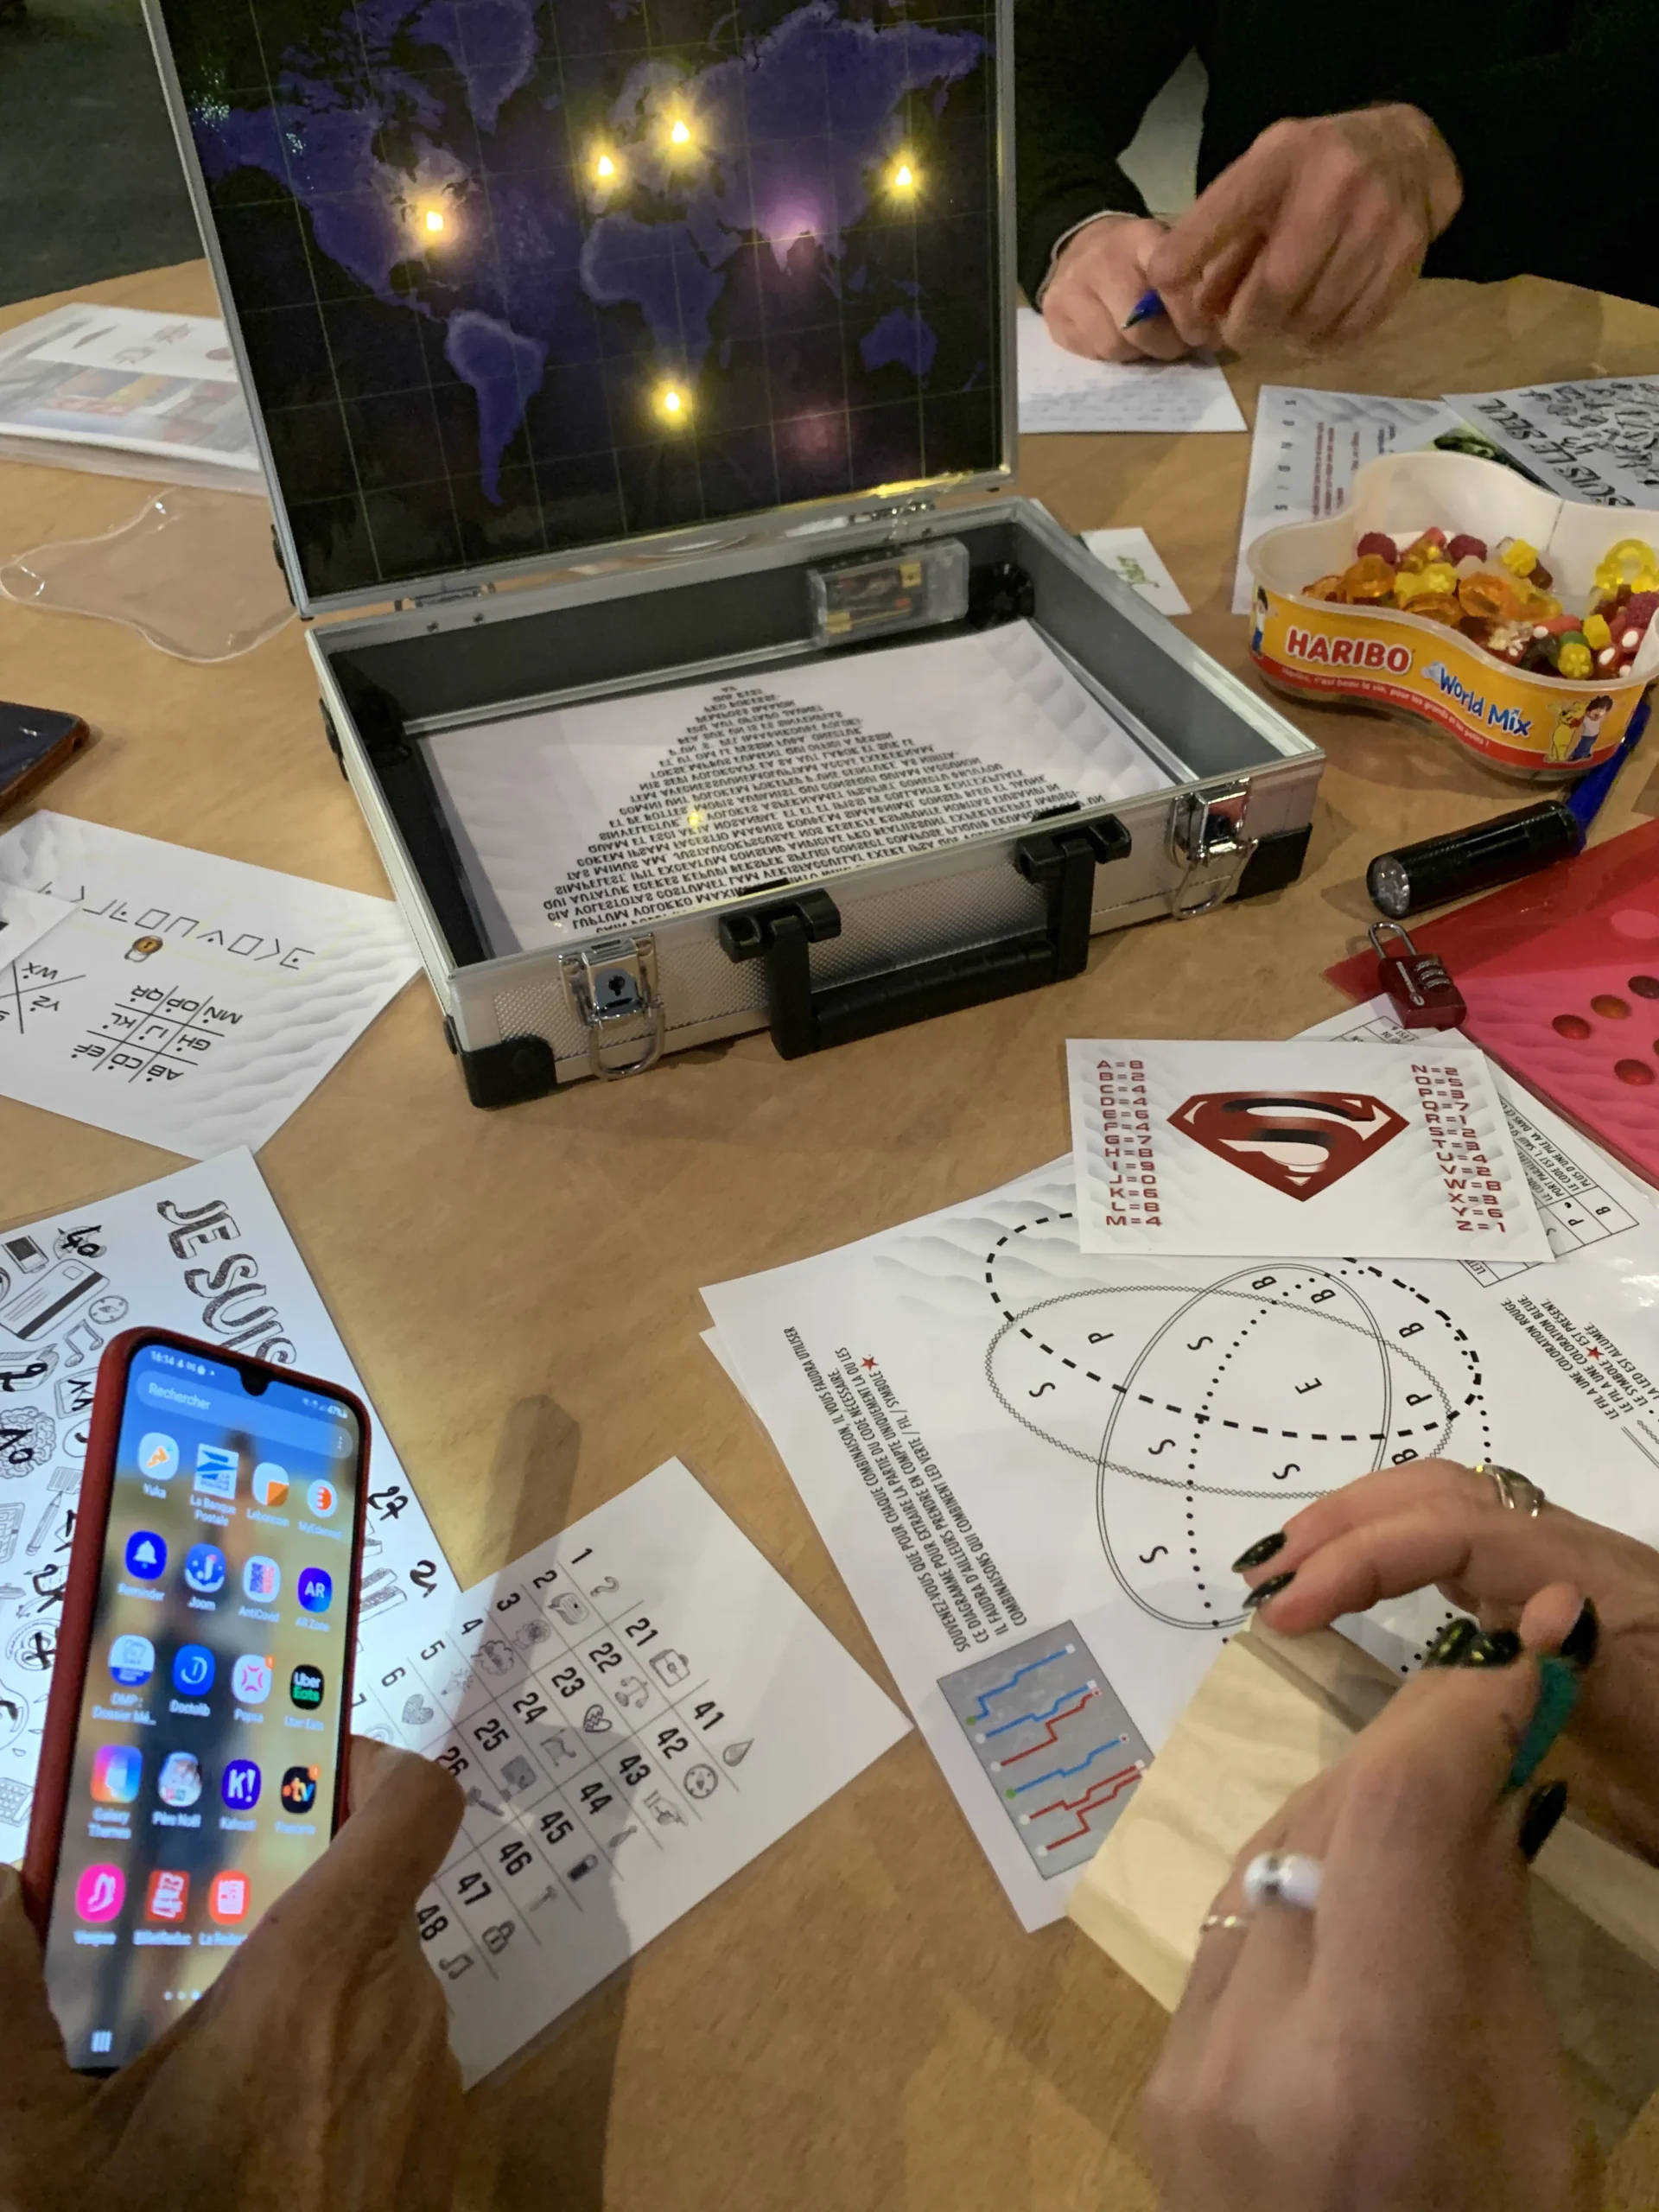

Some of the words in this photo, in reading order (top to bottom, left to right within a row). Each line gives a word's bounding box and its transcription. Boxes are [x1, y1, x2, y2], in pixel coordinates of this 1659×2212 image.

[1287, 628, 1410, 673] HARIBO
[1439, 667, 1484, 715] World
[1488, 704, 1532, 736] Mix
[22, 962, 59, 981] WX
[32, 995, 60, 1011] YZ
[131, 985, 164, 1001] QR
[167, 997, 200, 1013] OP
[110, 1012, 137, 1029] KL
[205, 1005, 243, 1025] MN
[145, 1025, 168, 1039] IJ
[178, 1033, 212, 1051] GH
[75, 1044, 105, 1058] EF
[111, 1052, 143, 1070] CD
[148, 1063, 183, 1081] AB
[1595, 1206, 1611, 1215] B
[156, 1199, 241, 1261] JE
[1251, 1275, 1277, 1290] B
[1310, 1288, 1336, 1304] B
[1087, 1332, 1114, 1344] P
[1398, 1321, 1425, 1338] B
[1538, 1315, 1587, 1368] COLORATION
[1570, 1328, 1590, 1349] EST
[782, 1325, 810, 1362] UTILISER
[834, 1345, 852, 1363] LES
[1186, 1336, 1213, 1351] S
[1524, 1321, 1573, 1374] COLORATION
[800, 1357, 828, 1394] FAUDRA
[1582, 1362, 1605, 1384] UNE
[1616, 1354, 1636, 1375] EST
[868, 1368, 899, 1410] SYMBOLE
[1028, 1382, 1056, 1398] S
[1295, 1377, 1323, 1395] E
[1568, 1368, 1590, 1391] UNE
[1598, 1356, 1638, 1399] SYMBOLE
[149, 1382, 211, 1410] Rechercher
[817, 1389, 840, 1416] VOUS
[824, 1366, 862, 1421] NÉCESSAIRE.
[1405, 1392, 1433, 1407] P
[1592, 1393, 1610, 1411] FIL
[1606, 1386, 1624, 1404] FIL
[856, 1383, 897, 1442] UNIQUEMENT
[893, 1410, 912, 1430] FIL
[853, 1415, 875, 1443] CODE
[836, 1421, 880, 1488] COMBINAISON,
[887, 1438, 917, 1477] COMPTE
[907, 1434, 932, 1465] VERTE
[1147, 1439, 1175, 1455] S
[1391, 1448, 1420, 1466] B
[874, 1454, 901, 1488] PARTIE
[922, 1461, 943, 1483] LED
[1272, 1463, 1300, 1480] S
[368, 1485, 410, 1522] 27
[869, 1484, 900, 1525] CHAQUE
[915, 1485, 949, 1533] PRENDRE
[933, 1478, 974, 1535] COMBINENT
[898, 1496, 932, 1543] EXTRAIRE
[891, 1522, 915, 1552] POUR
[963, 1530, 985, 1554] QUI
[570, 1548, 593, 1565] 1
[905, 1548, 926, 1573] QUE
[922, 1539, 948, 1570] POUR
[938, 1527, 979, 1586] D'AILLEURS
[1139, 1545, 1168, 1564] S
[305, 1581, 326, 1598] AR
[533, 1569, 557, 1588] 2
[976, 1548, 1028, 1630] COMBINAISONS
[497, 1591, 520, 1611] 3
[938, 1566, 982, 1630] DIAGRAMME
[969, 1581, 1001, 1625] FAUDRA
[917, 1569, 970, 1654] SOUVENEZ-VOUS
[460, 1617, 483, 1636] 4
[626, 1618, 658, 1648] 21
[421, 1641, 445, 1662] 5
[588, 1642, 623, 1673] 22
[294, 1673, 321, 1688] Uber
[382, 1667, 405, 1688] 6
[551, 1667, 585, 1699] 23
[512, 1692, 547, 1725] 24
[694, 1700, 725, 1730] 41
[474, 1718, 509, 1751] 25
[656, 1726, 689, 1759] 42
[619, 1752, 652, 1786] 43
[581, 1782, 613, 1815] 44
[539, 1810, 574, 1844] 45
[499, 1840, 533, 1876] 46
[457, 1872, 492, 1906] 47
